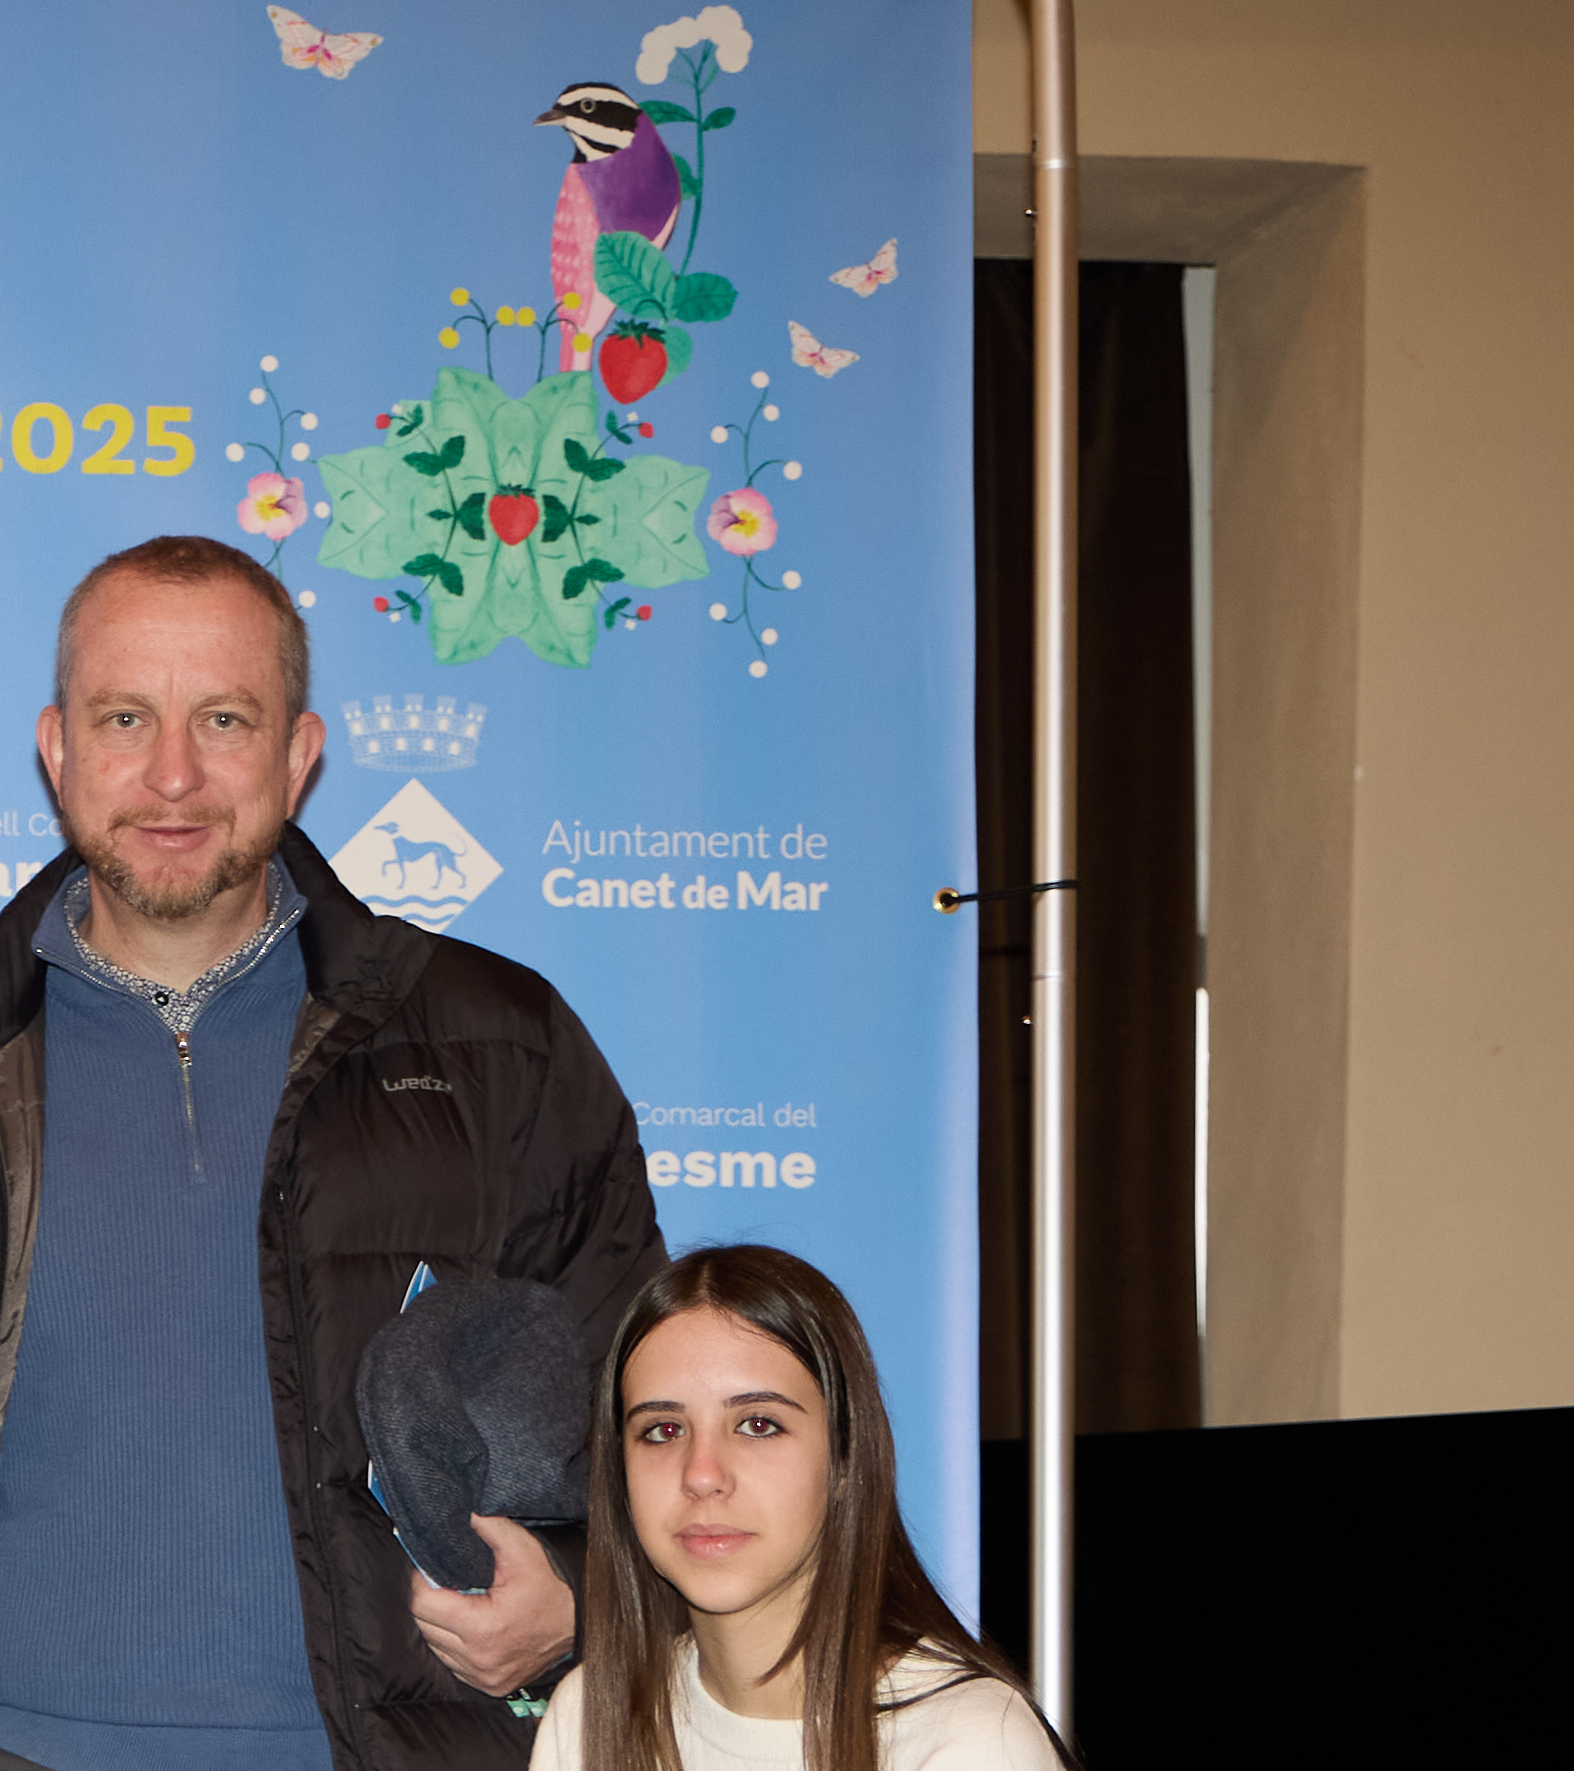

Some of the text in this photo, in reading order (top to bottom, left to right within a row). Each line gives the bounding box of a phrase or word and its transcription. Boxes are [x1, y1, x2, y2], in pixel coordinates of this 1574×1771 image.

[542, 820, 828, 864] Ajuntament de
[542, 867, 828, 910] Canet de Mar
[633, 1101, 816, 1128] Comarcal del
[646, 1150, 817, 1188] esme
